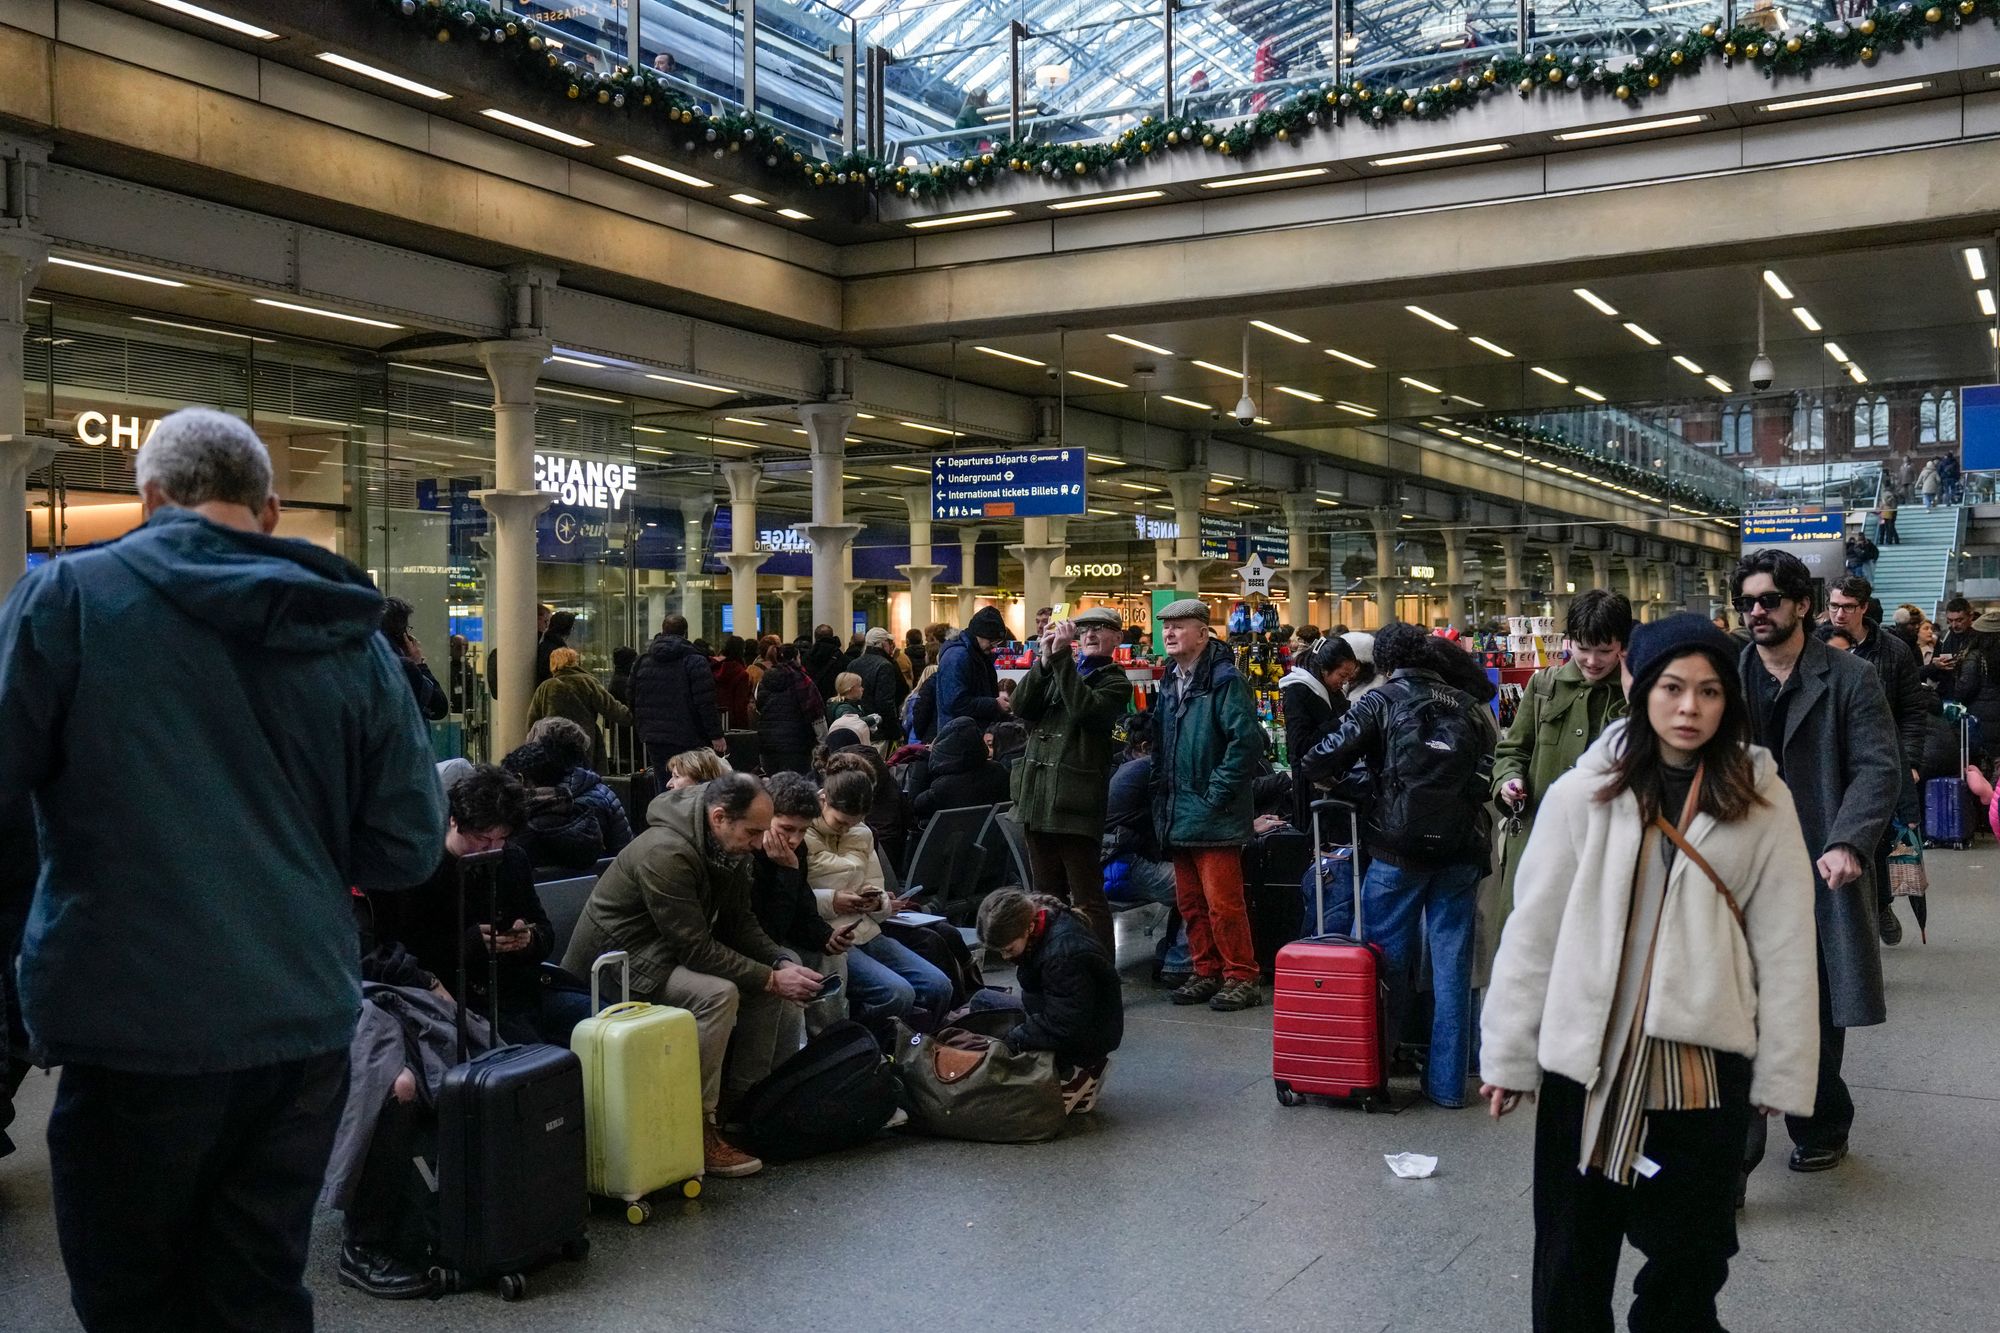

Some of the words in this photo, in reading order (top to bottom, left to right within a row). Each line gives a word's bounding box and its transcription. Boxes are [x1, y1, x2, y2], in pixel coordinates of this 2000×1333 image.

[948, 457, 994, 469] Departures
[995, 454, 1028, 466] Départs
[534, 454, 637, 491] CHANGE
[948, 472, 1002, 484] Underground
[948, 488, 1000, 499] International
[1002, 487, 1029, 497] tickets
[1031, 486, 1058, 496] Billets
[1084, 564, 1122, 577] FOOD
